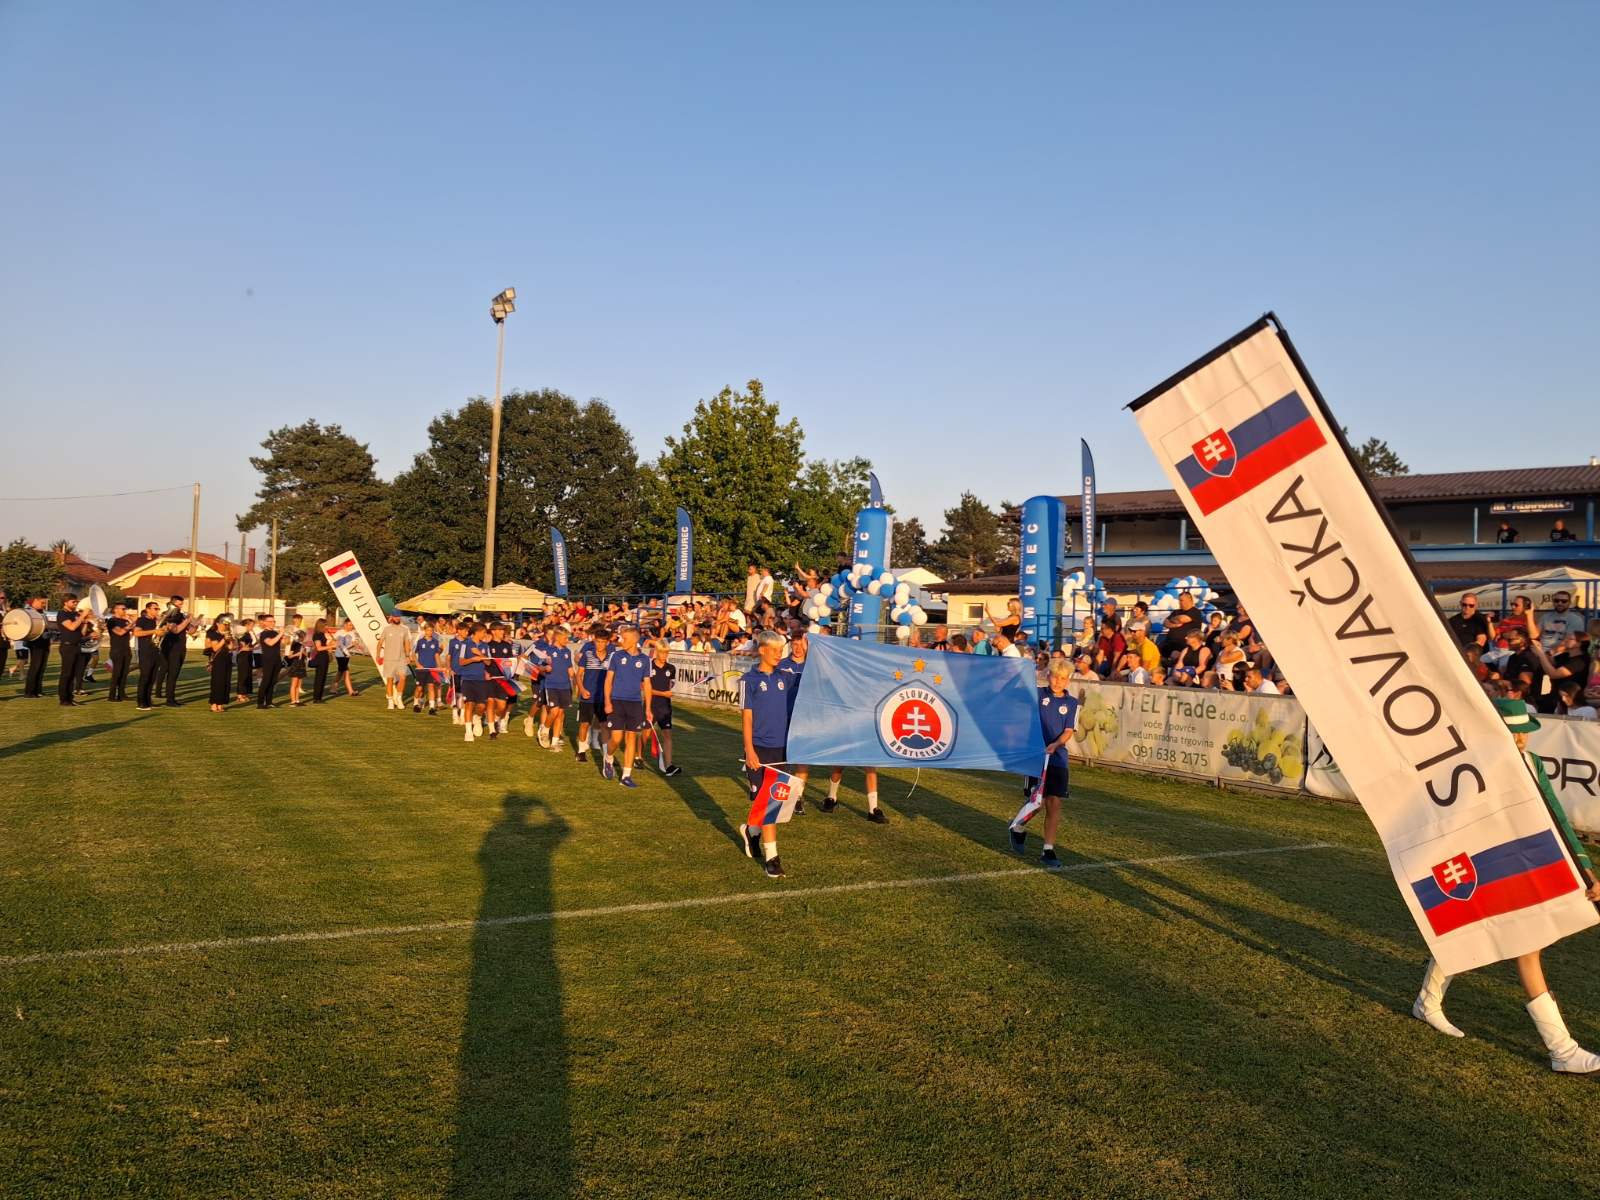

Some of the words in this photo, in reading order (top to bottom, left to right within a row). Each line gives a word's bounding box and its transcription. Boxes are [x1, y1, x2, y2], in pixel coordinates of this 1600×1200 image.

[1023, 522, 1039, 636] IMUREC
[349, 584, 381, 641] OATIA
[1266, 474, 1486, 807] SLOVAČKA
[899, 689, 936, 705] SLOVAN
[1167, 695, 1217, 720] Trade
[889, 740, 947, 758] BRATISLAVA
[1156, 747, 1177, 763] 638
[1180, 751, 1208, 767] 2175
[1539, 755, 1600, 797] PR
